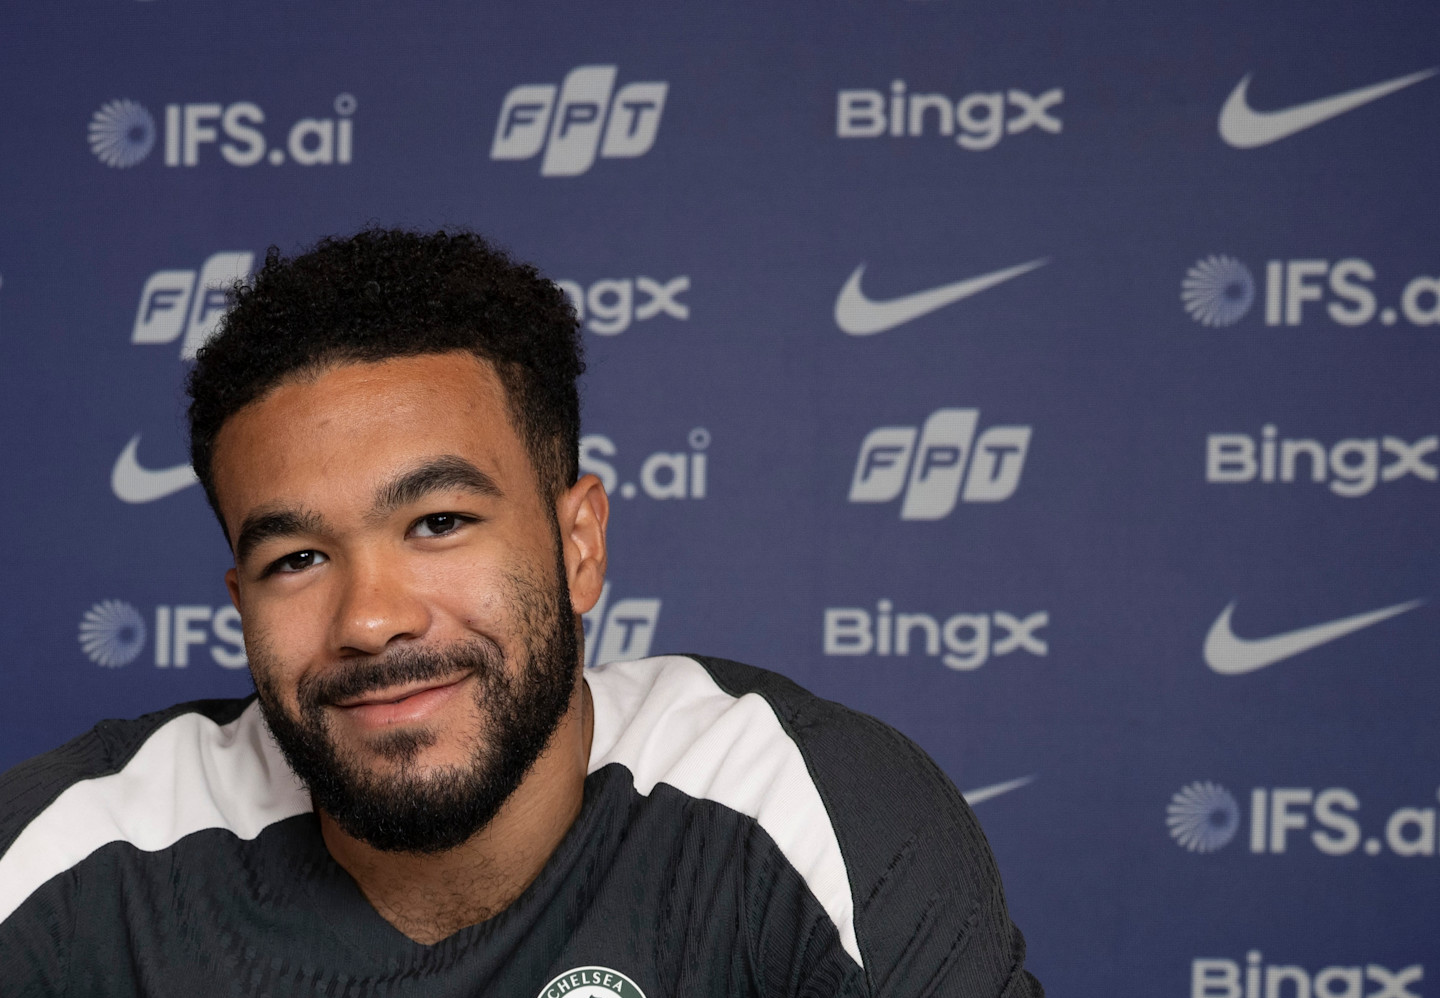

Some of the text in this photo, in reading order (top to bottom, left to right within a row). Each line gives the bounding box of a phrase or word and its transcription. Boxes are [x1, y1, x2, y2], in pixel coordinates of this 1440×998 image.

[165, 95, 355, 166] IFS.ai
[1265, 259, 1440, 326] IFS.a
[578, 428, 710, 498] S.ai
[155, 605, 248, 669] IFS
[1250, 788, 1436, 856] IFS.a
